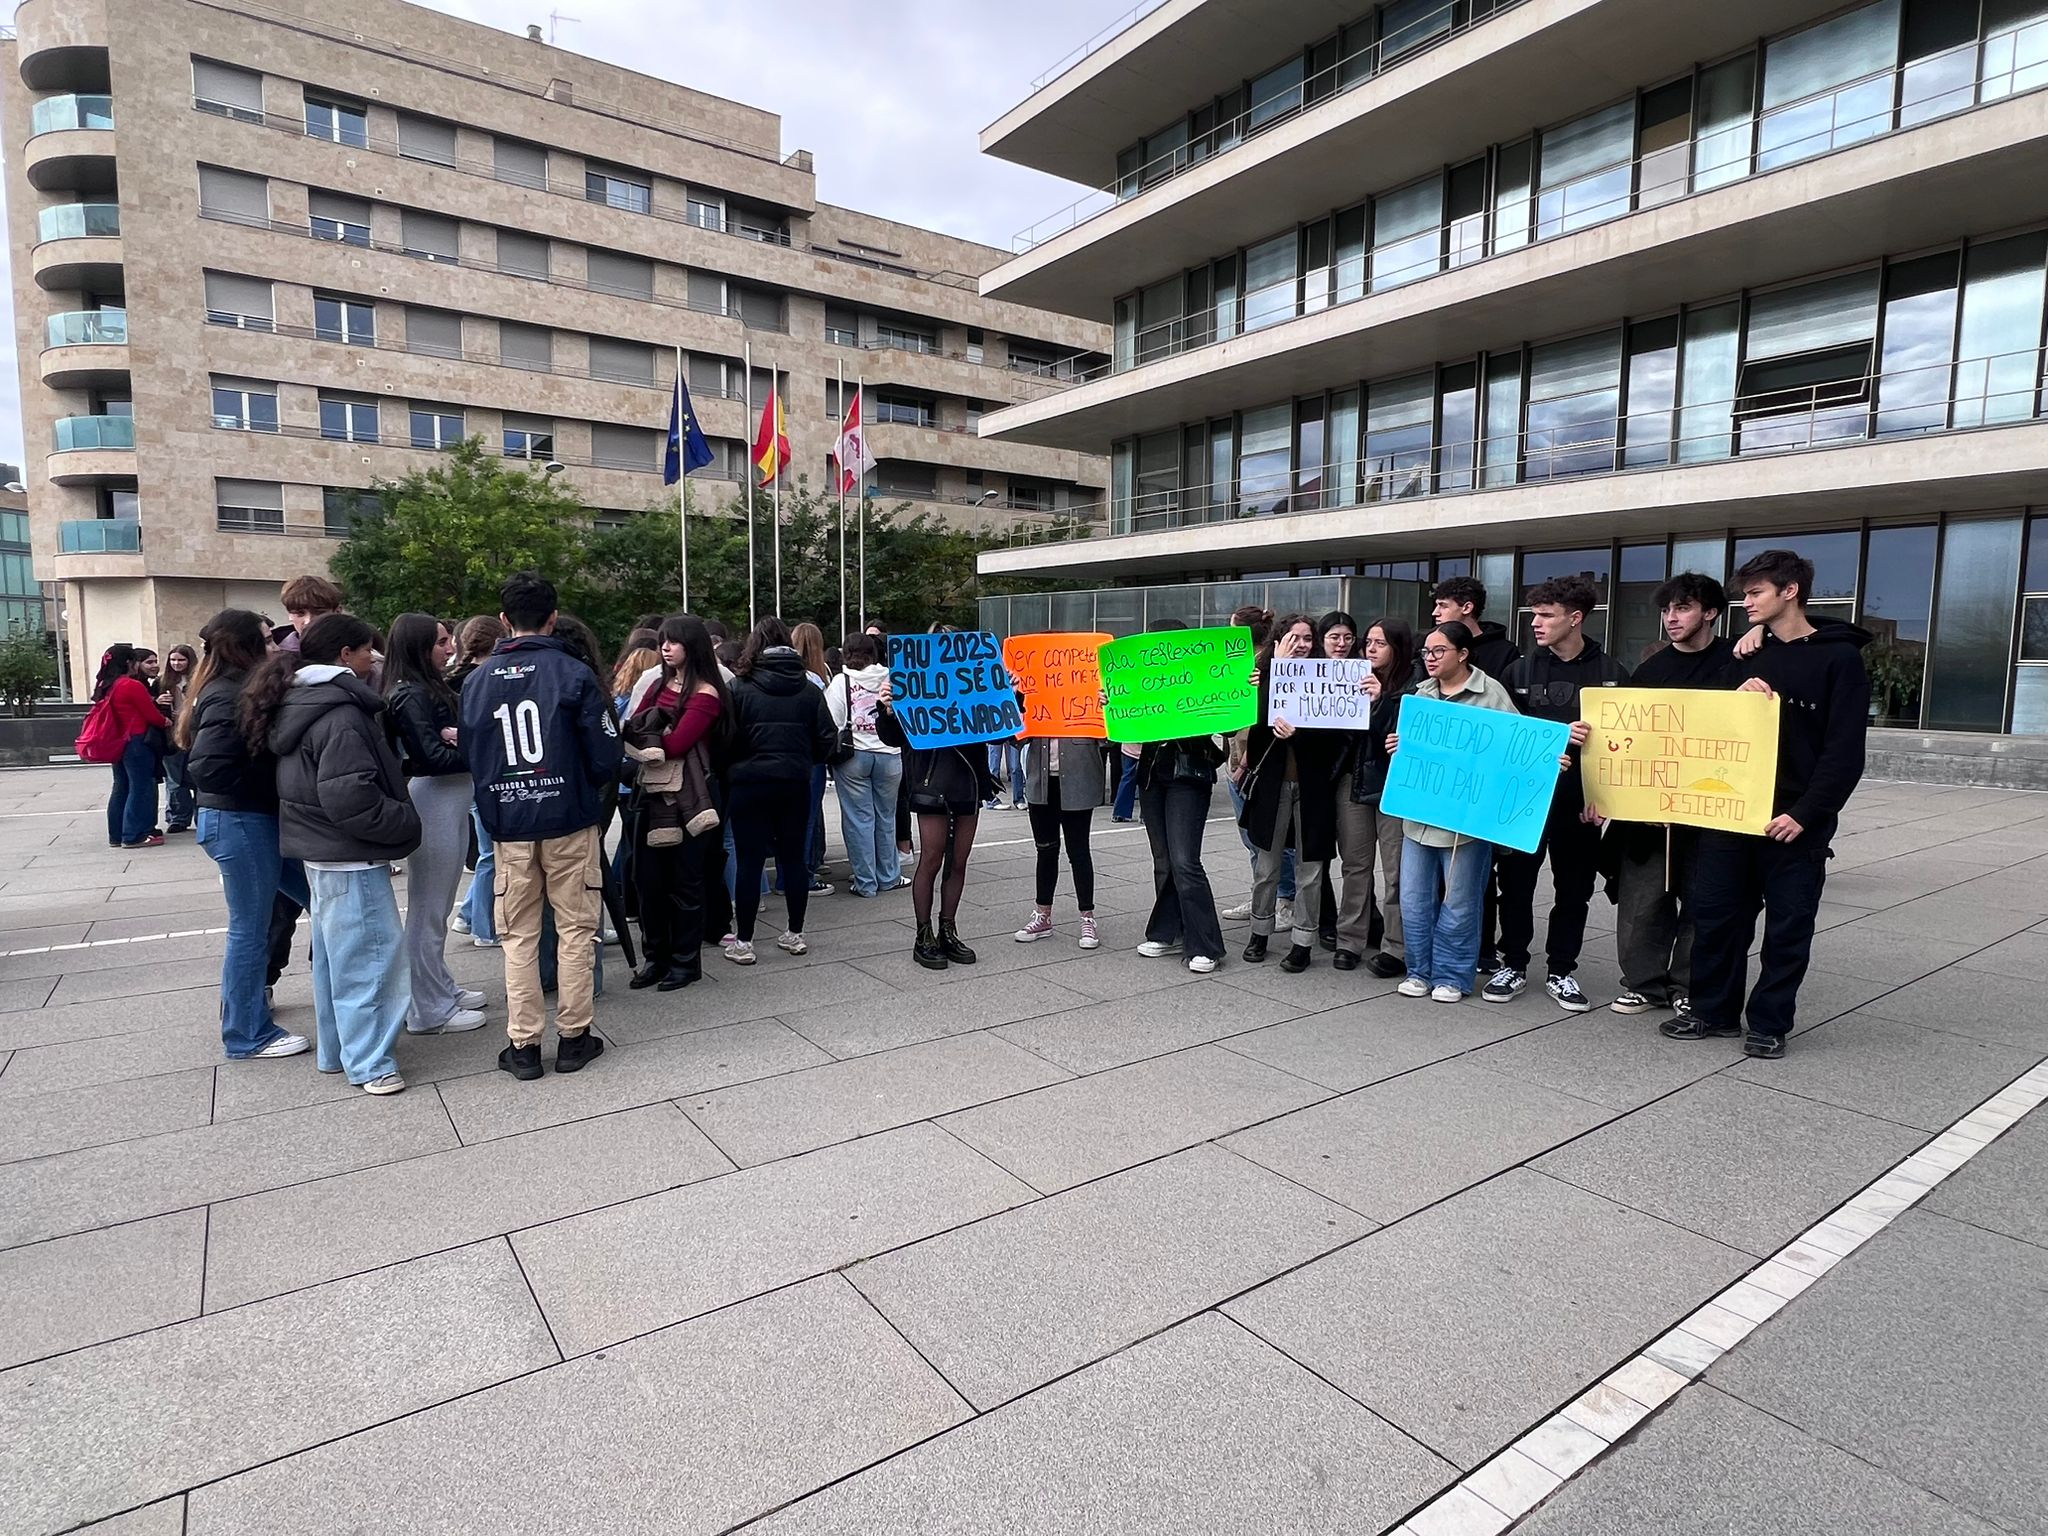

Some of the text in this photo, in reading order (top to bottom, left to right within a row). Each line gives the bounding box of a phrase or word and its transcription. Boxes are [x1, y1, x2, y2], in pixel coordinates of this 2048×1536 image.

[888, 633, 997, 669] PAU 2025
[1106, 638, 1247, 673] La reflexión NO
[890, 661, 1008, 700] SOLO SÉ Q
[1020, 675, 1036, 688] NO
[1045, 673, 1063, 688] ME
[1106, 663, 1234, 697] ha estado en
[1274, 662, 1306, 677] LUCHA
[1317, 663, 1329, 677] DE
[1275, 682, 1296, 694] POR
[1304, 682, 1315, 694] EL
[1108, 688, 1251, 720] nuestra EDUCACIÓN
[1274, 699, 1287, 709] DE
[1601, 702, 1684, 732] EXAMEN
[493, 700, 544, 766] 10
[1408, 711, 1560, 772] ANSIEDAD 100%
[1658, 736, 1750, 762] INCIERTO
[540, 776, 565, 787] ITALIA
[1600, 757, 1679, 788] FUTURO
[1398, 755, 1546, 825] INFO PAU 0%
[1660, 793, 1745, 821] DESIERTO
